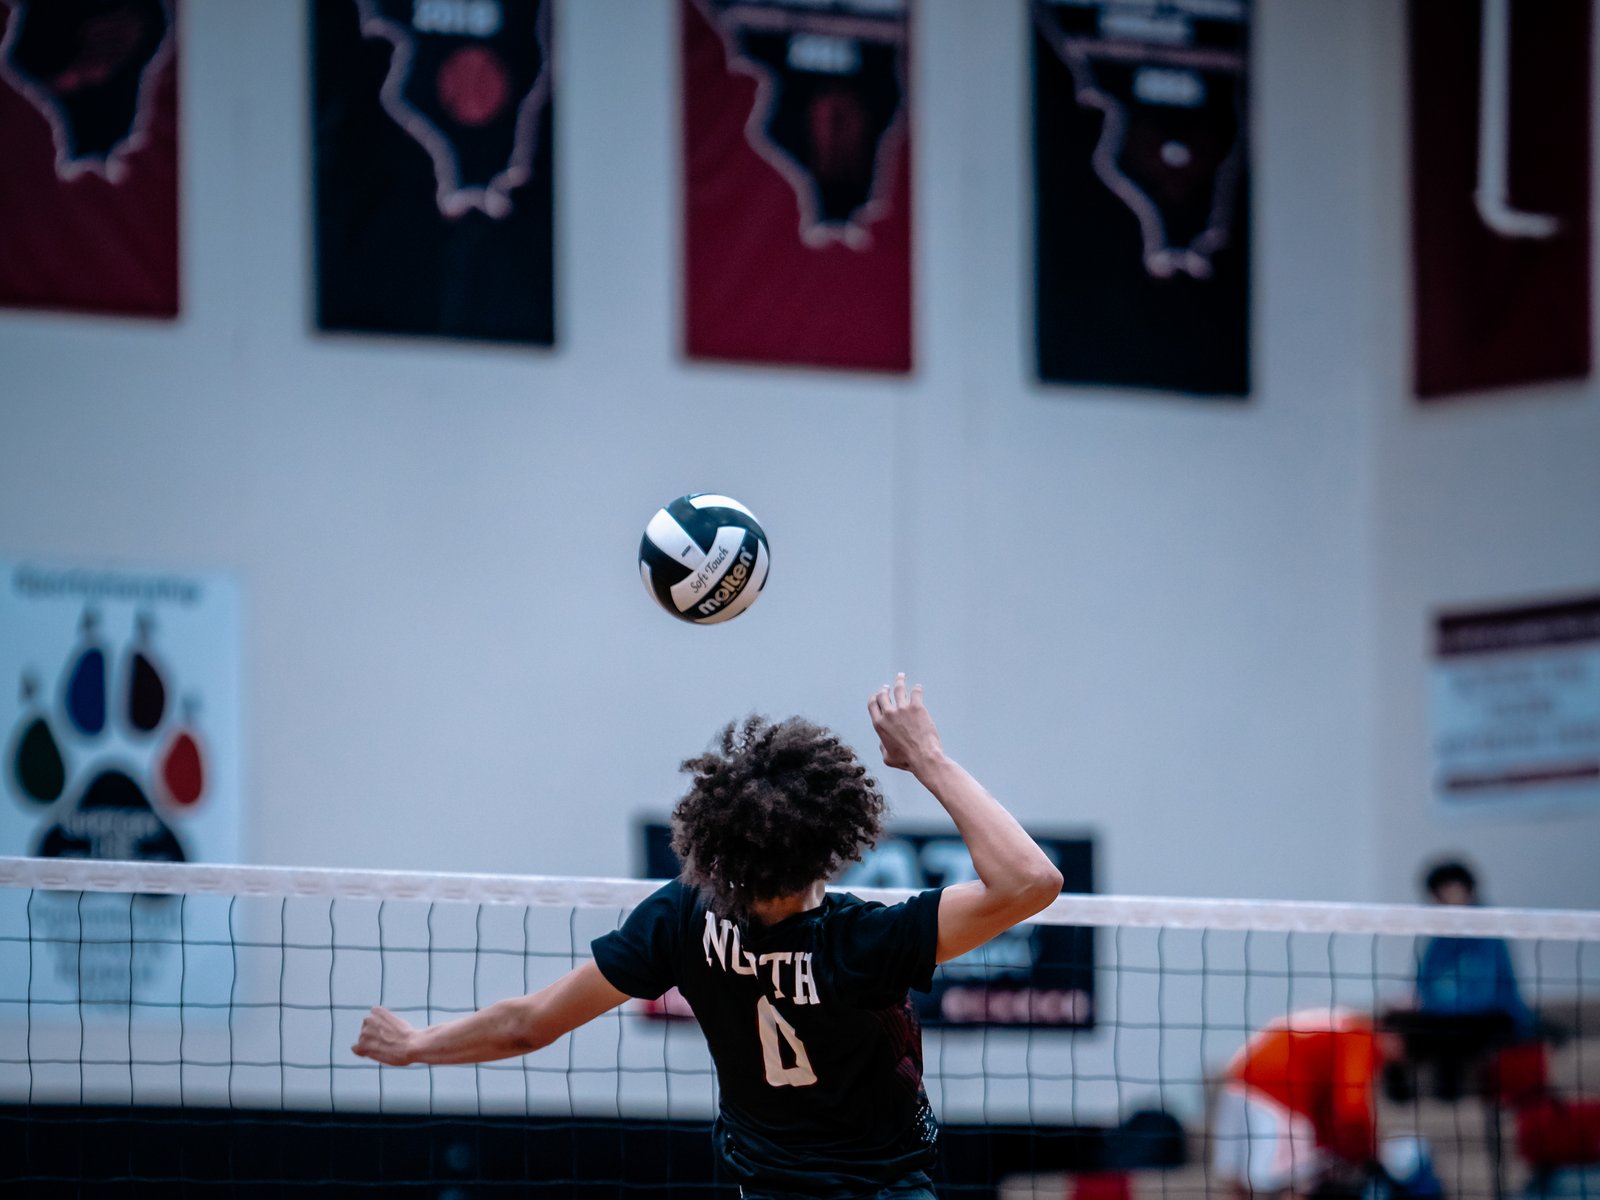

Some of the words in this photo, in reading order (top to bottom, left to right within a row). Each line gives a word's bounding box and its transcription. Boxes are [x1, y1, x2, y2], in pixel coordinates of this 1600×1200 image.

[690, 569, 708, 594] Soft
[705, 546, 729, 574] Touch
[698, 551, 753, 615] molten
